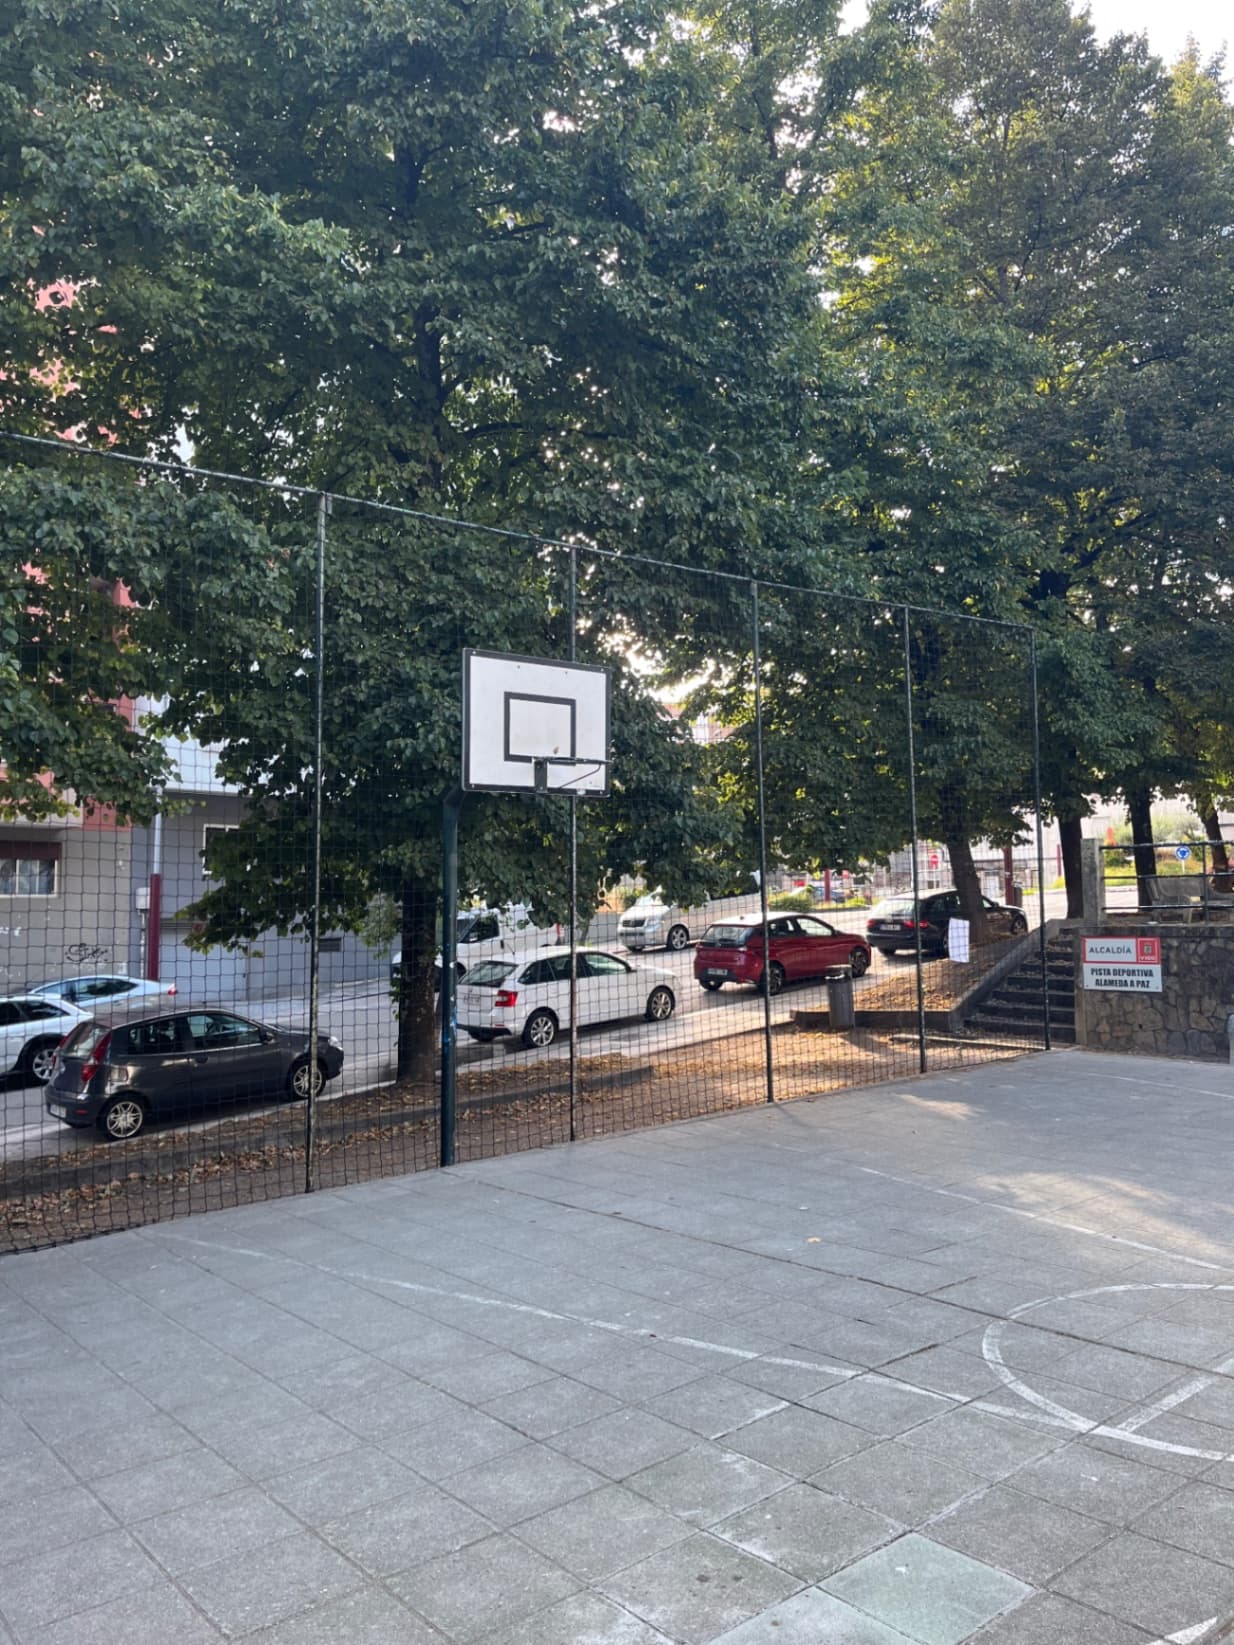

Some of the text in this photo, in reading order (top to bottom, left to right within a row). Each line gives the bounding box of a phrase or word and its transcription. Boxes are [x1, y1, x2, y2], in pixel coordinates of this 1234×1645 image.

[1089, 945, 1132, 954] ALCALDÍA
[1091, 968, 1154, 977] PISTA DEPORTIVA
[1095, 979, 1128, 987] ALAMEDA
[1136, 980, 1150, 988] PAZ
